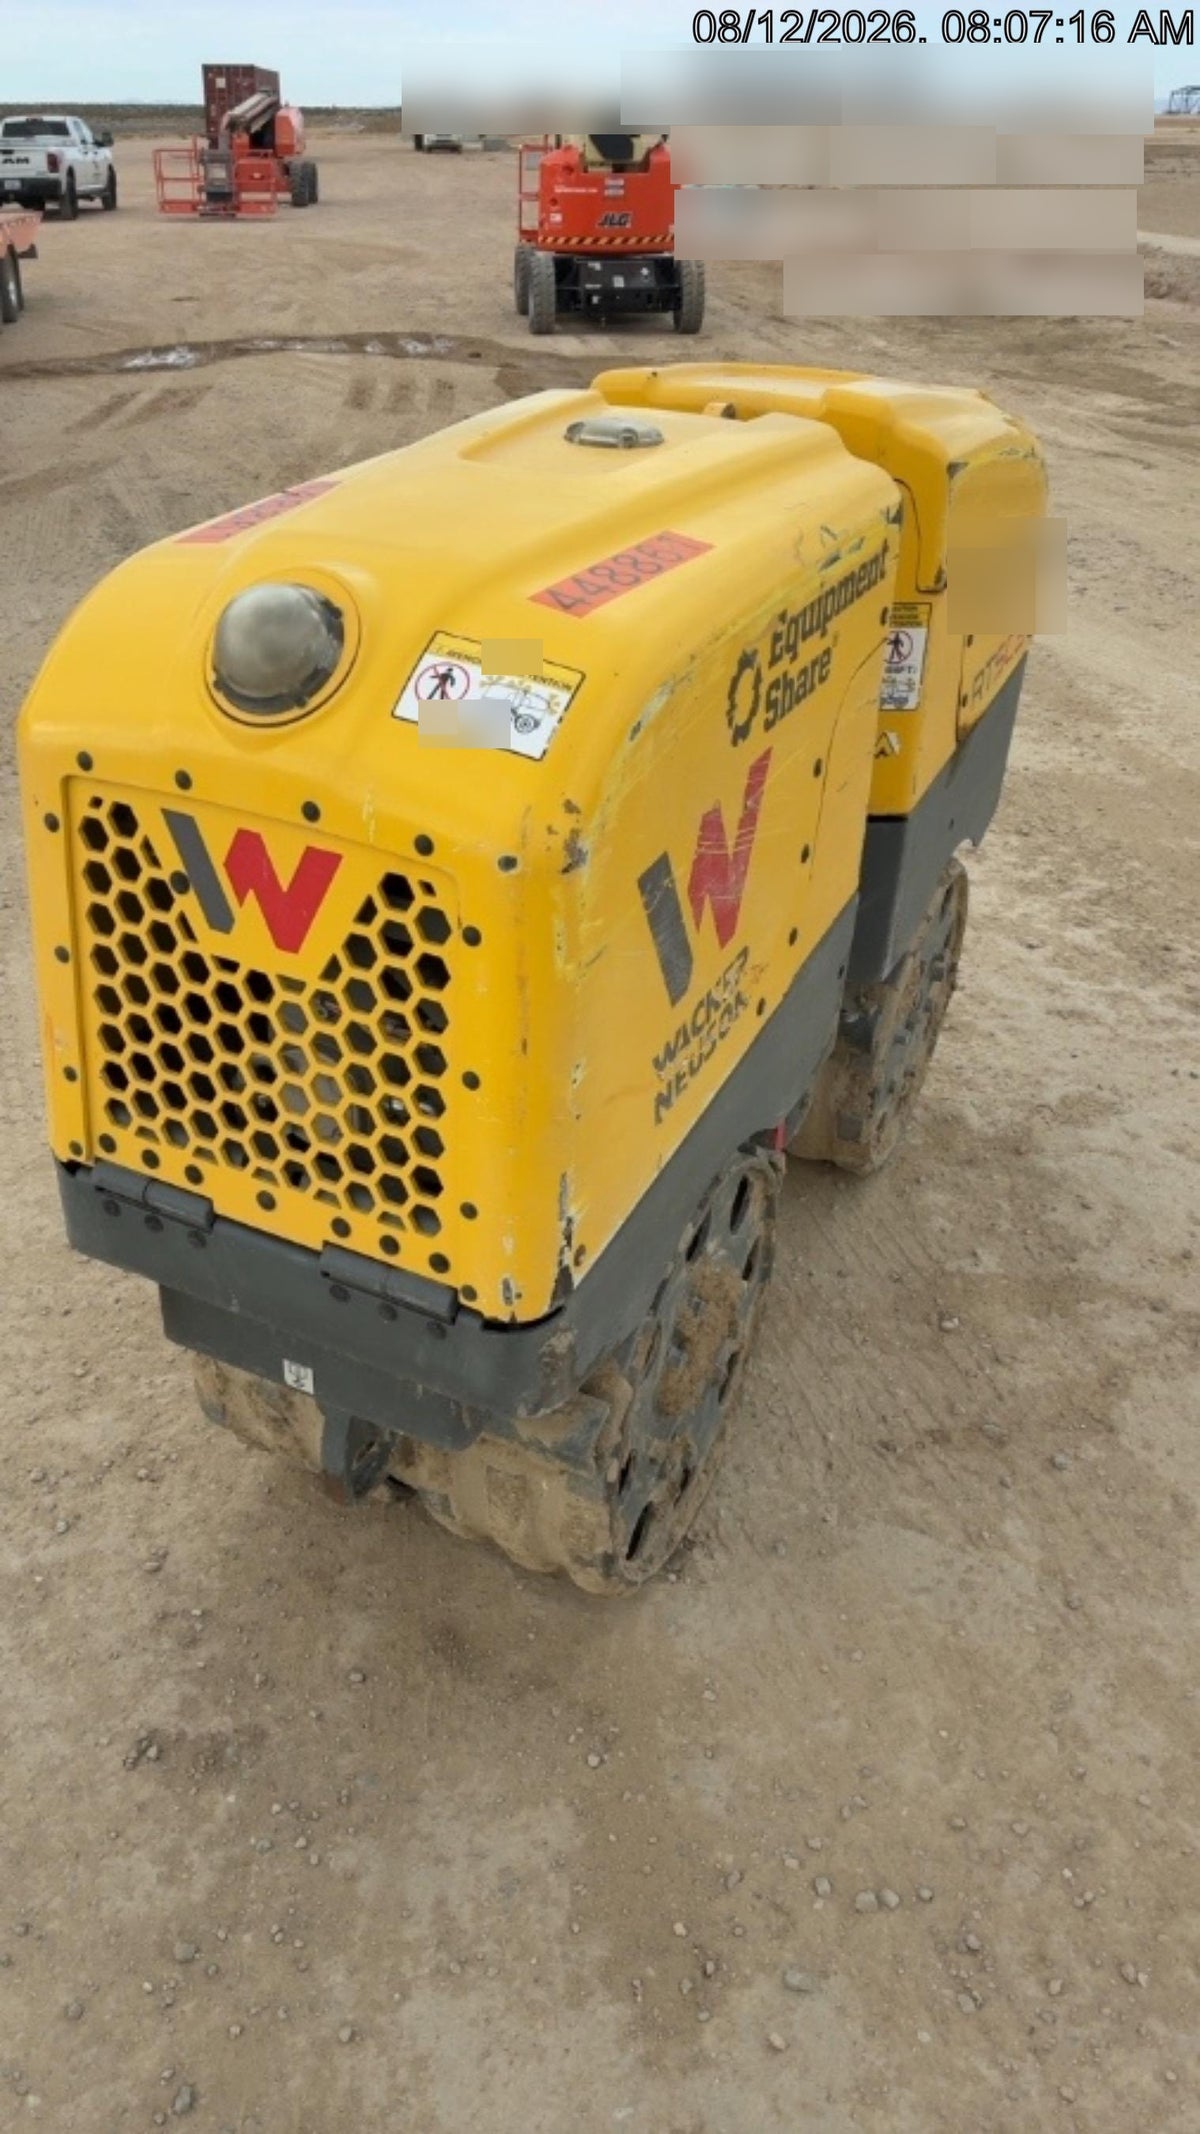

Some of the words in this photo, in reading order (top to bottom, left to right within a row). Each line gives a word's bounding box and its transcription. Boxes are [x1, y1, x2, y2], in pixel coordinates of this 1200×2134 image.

[598, 213, 630, 226] JLG
[769, 538, 889, 669] Equipment
[764, 646, 832, 732] Share
